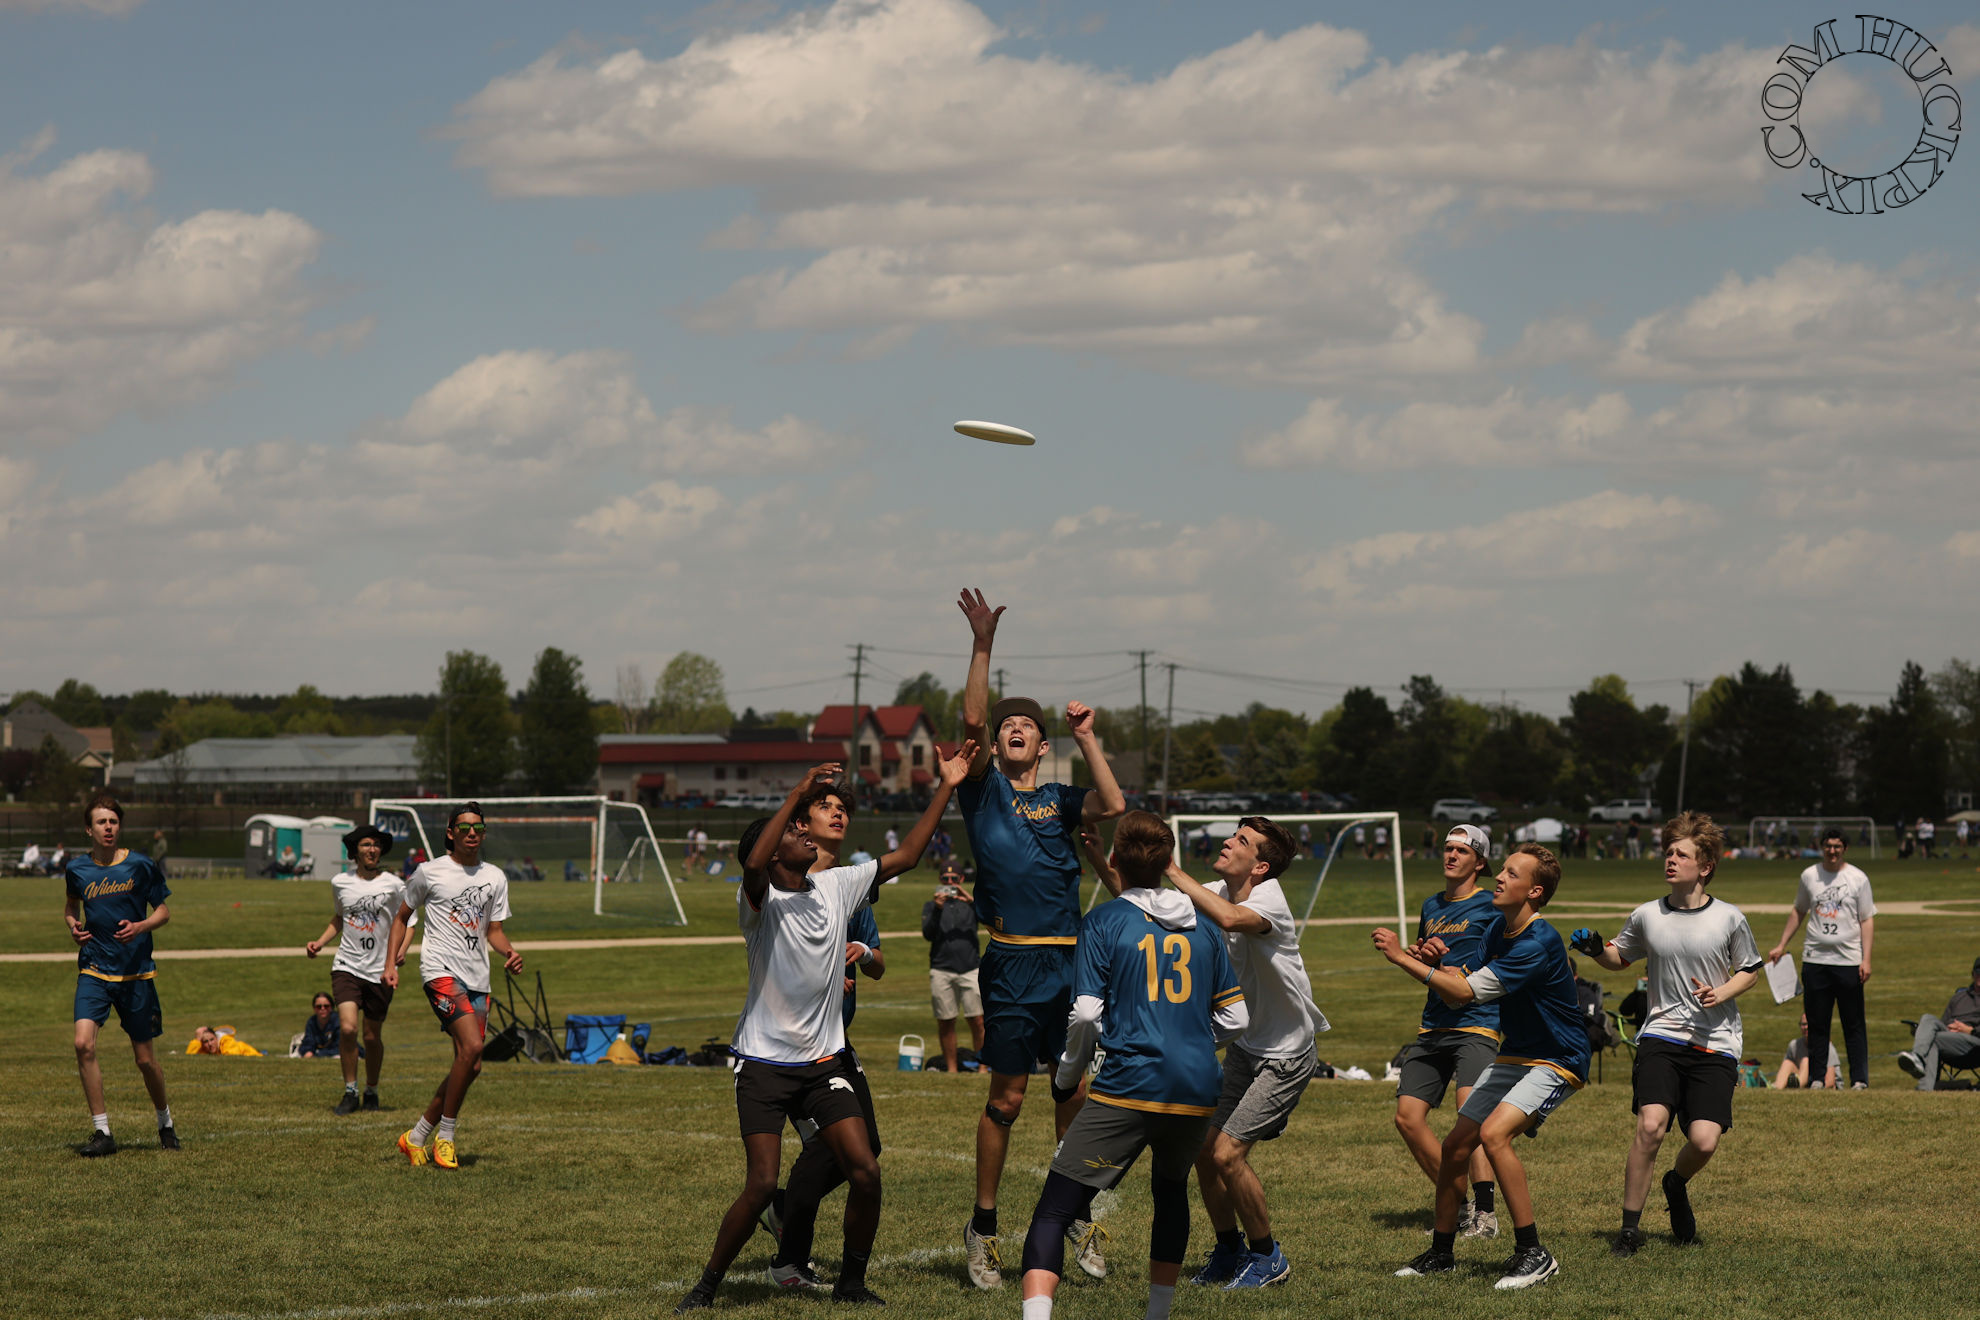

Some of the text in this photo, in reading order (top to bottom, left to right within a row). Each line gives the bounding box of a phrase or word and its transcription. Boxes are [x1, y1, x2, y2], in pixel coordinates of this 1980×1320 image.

[377, 815, 409, 837] 202
[84, 877, 134, 899] Wildcats
[1823, 924, 1838, 935] 32
[360, 938, 374, 950] 10
[465, 936, 478, 950] 17
[1137, 933, 1192, 1004] 13
